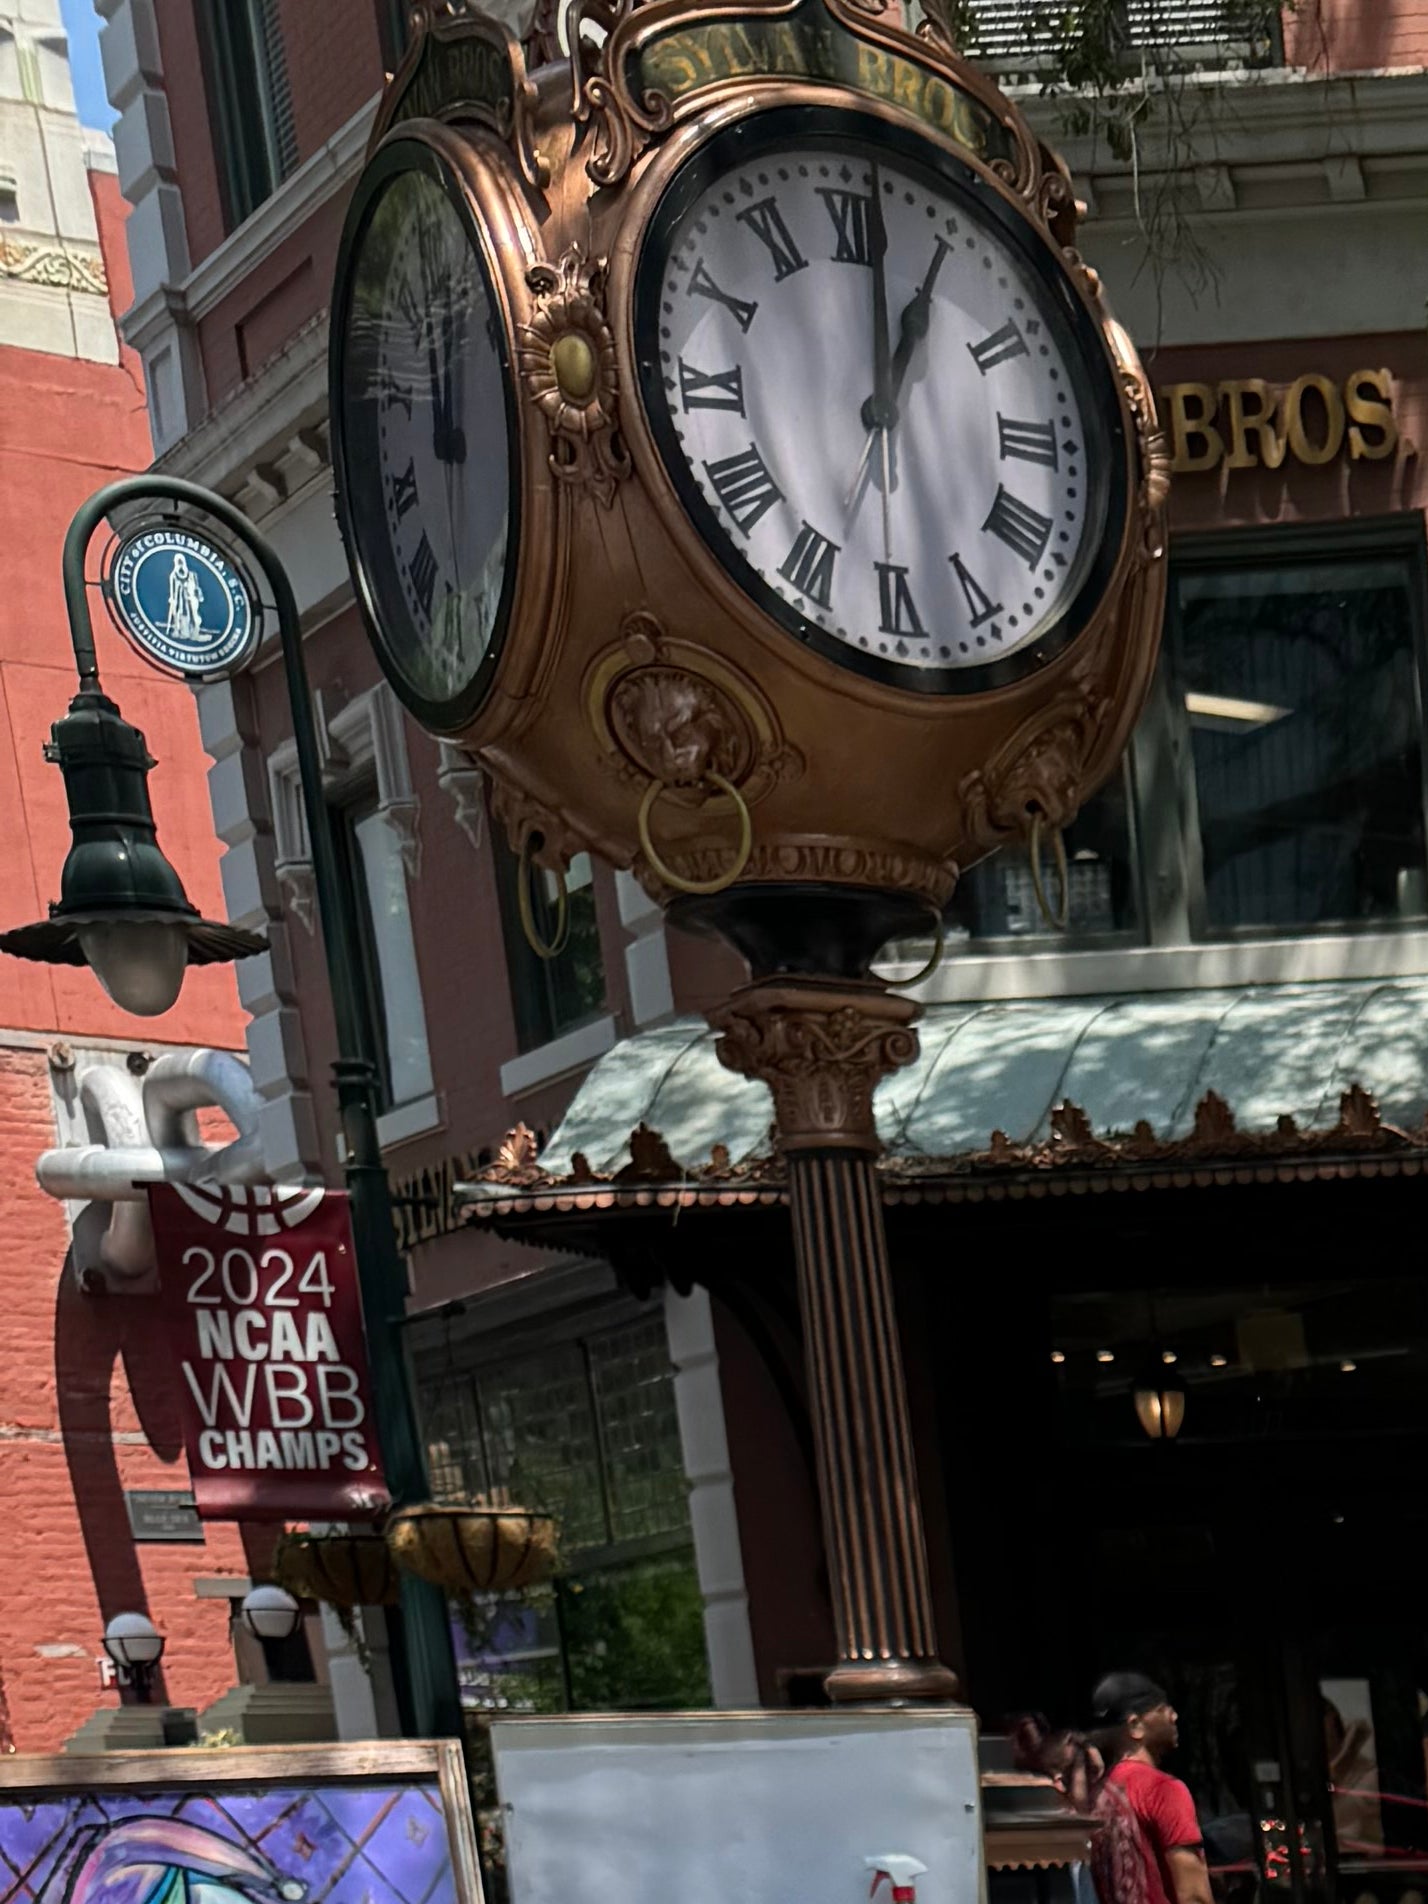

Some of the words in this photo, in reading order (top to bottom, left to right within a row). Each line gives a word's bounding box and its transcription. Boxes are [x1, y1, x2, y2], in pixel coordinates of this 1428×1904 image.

[687, 257, 758, 334] X
[966, 317, 1030, 376] II
[996, 411, 1058, 473] III
[701, 441, 787, 539] VIII
[120, 555, 135, 596] CITY
[776, 519, 841, 612] VII
[948, 552, 1004, 628] V
[873, 560, 929, 638] VI
[182, 1247, 335, 1308] 2024
[196, 1309, 340, 1361] NCAA
[182, 1361, 365, 1428] WBB
[199, 1429, 369, 1471] CHAMPS
